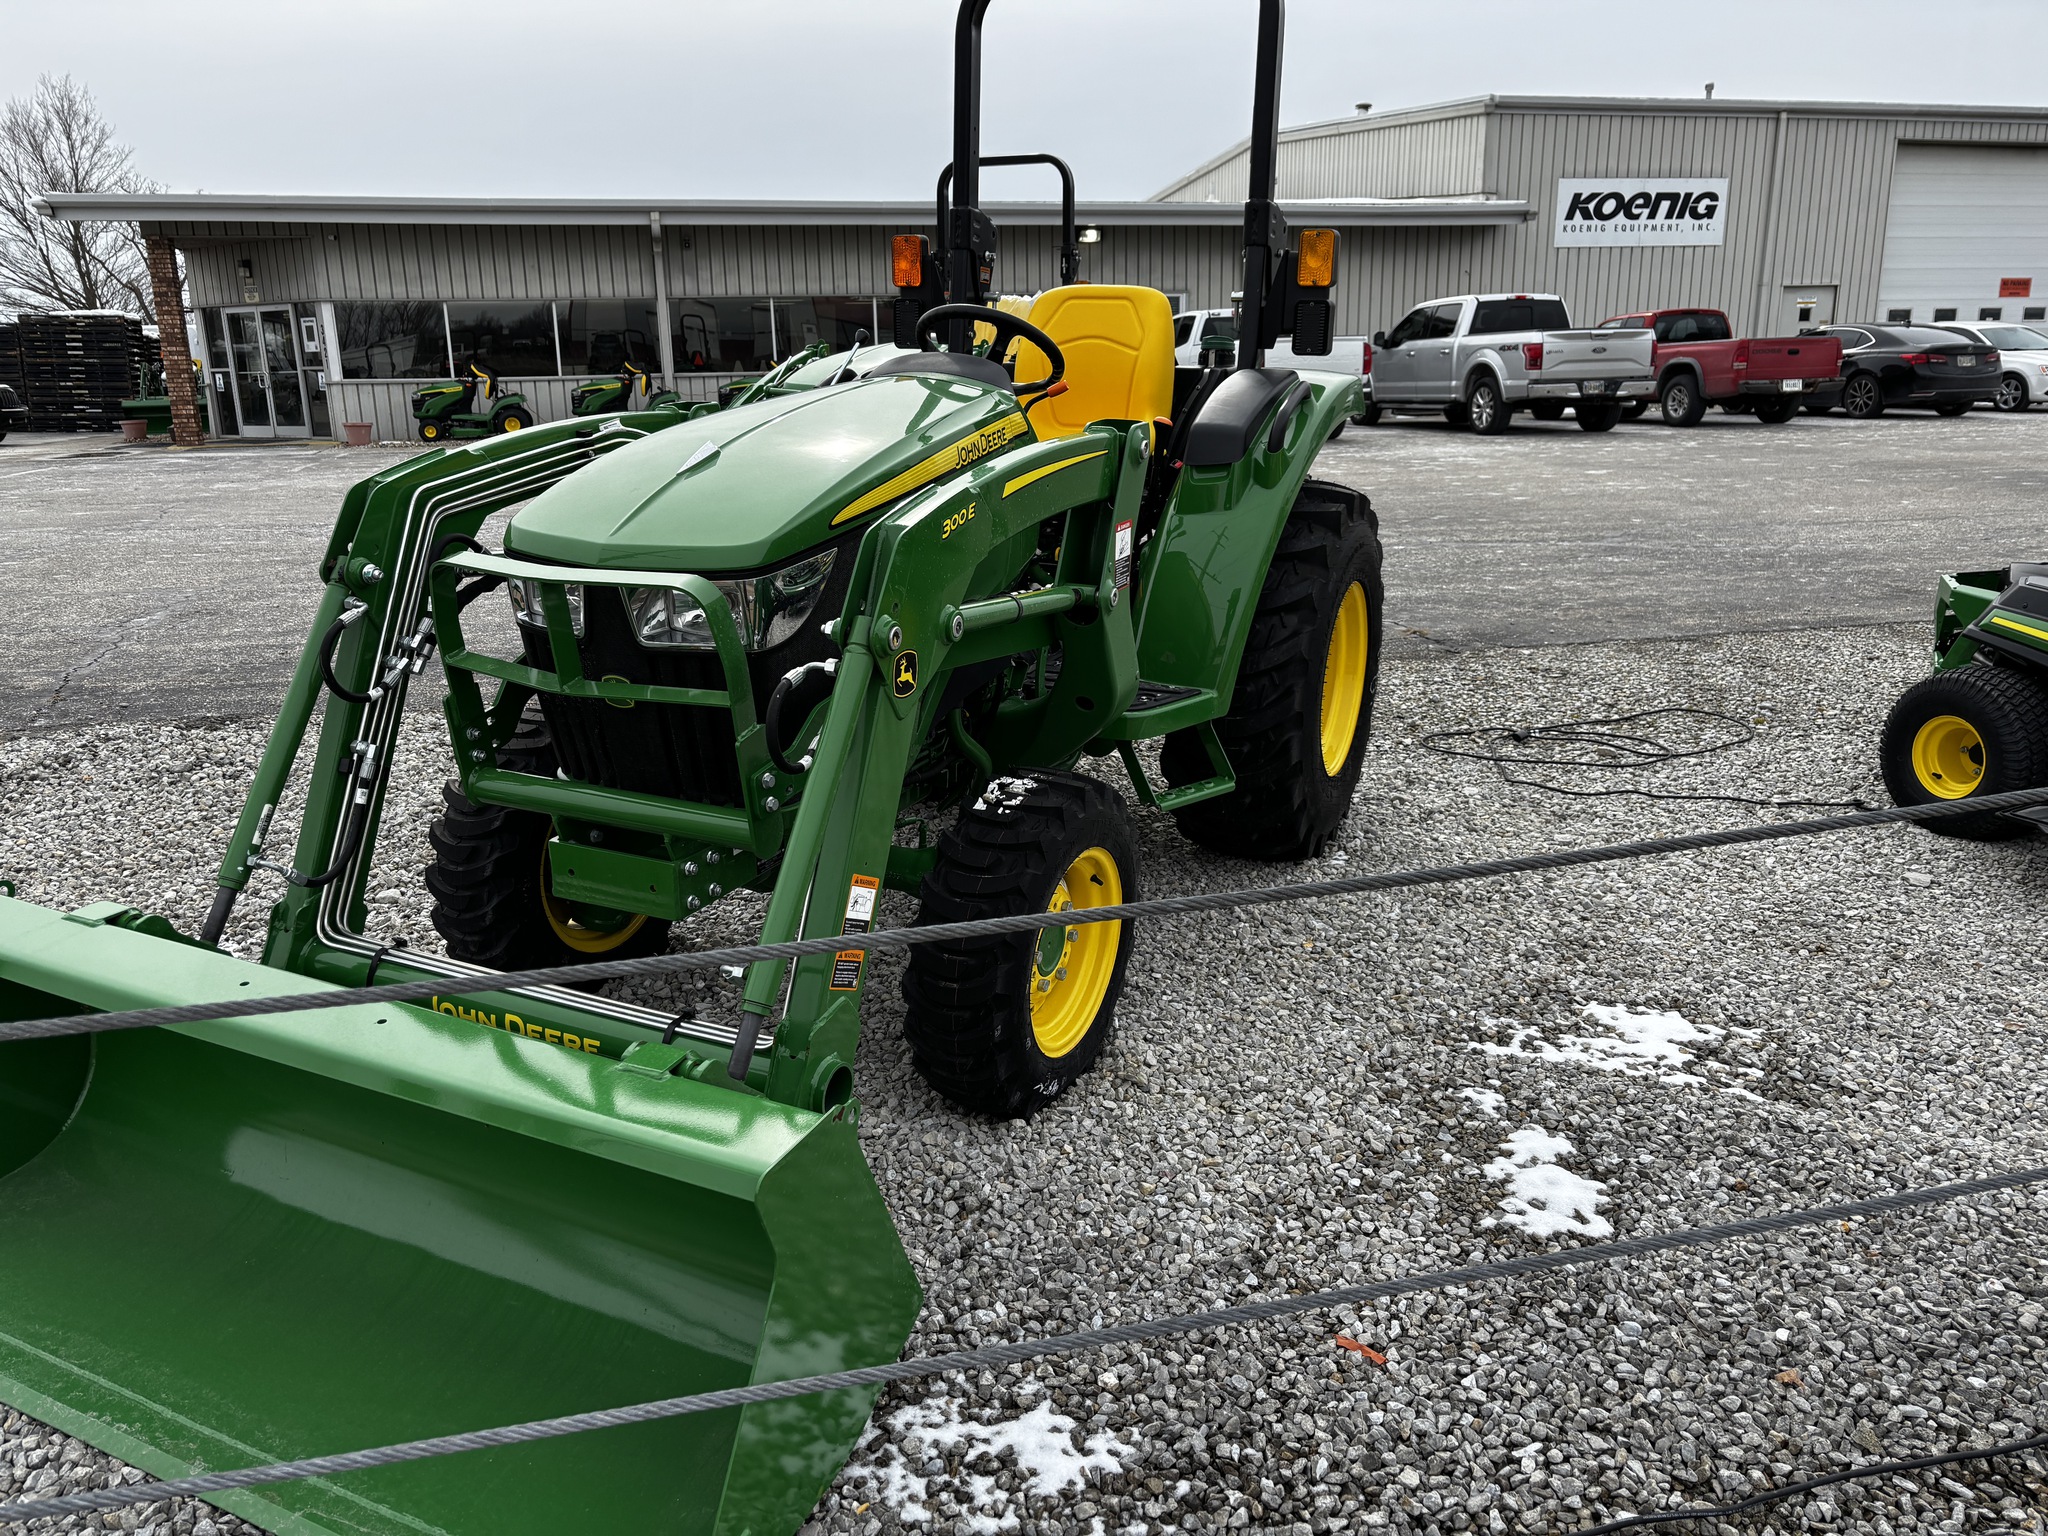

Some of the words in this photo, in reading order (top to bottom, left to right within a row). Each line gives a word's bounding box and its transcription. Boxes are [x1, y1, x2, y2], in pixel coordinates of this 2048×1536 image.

[1563, 224, 1606, 233] KOENIG
[1614, 223, 1684, 233] EQUIPMENT,
[1692, 223, 1716, 232] INC.
[955, 440, 982, 468] JOHN
[980, 427, 1008, 455] DEERE
